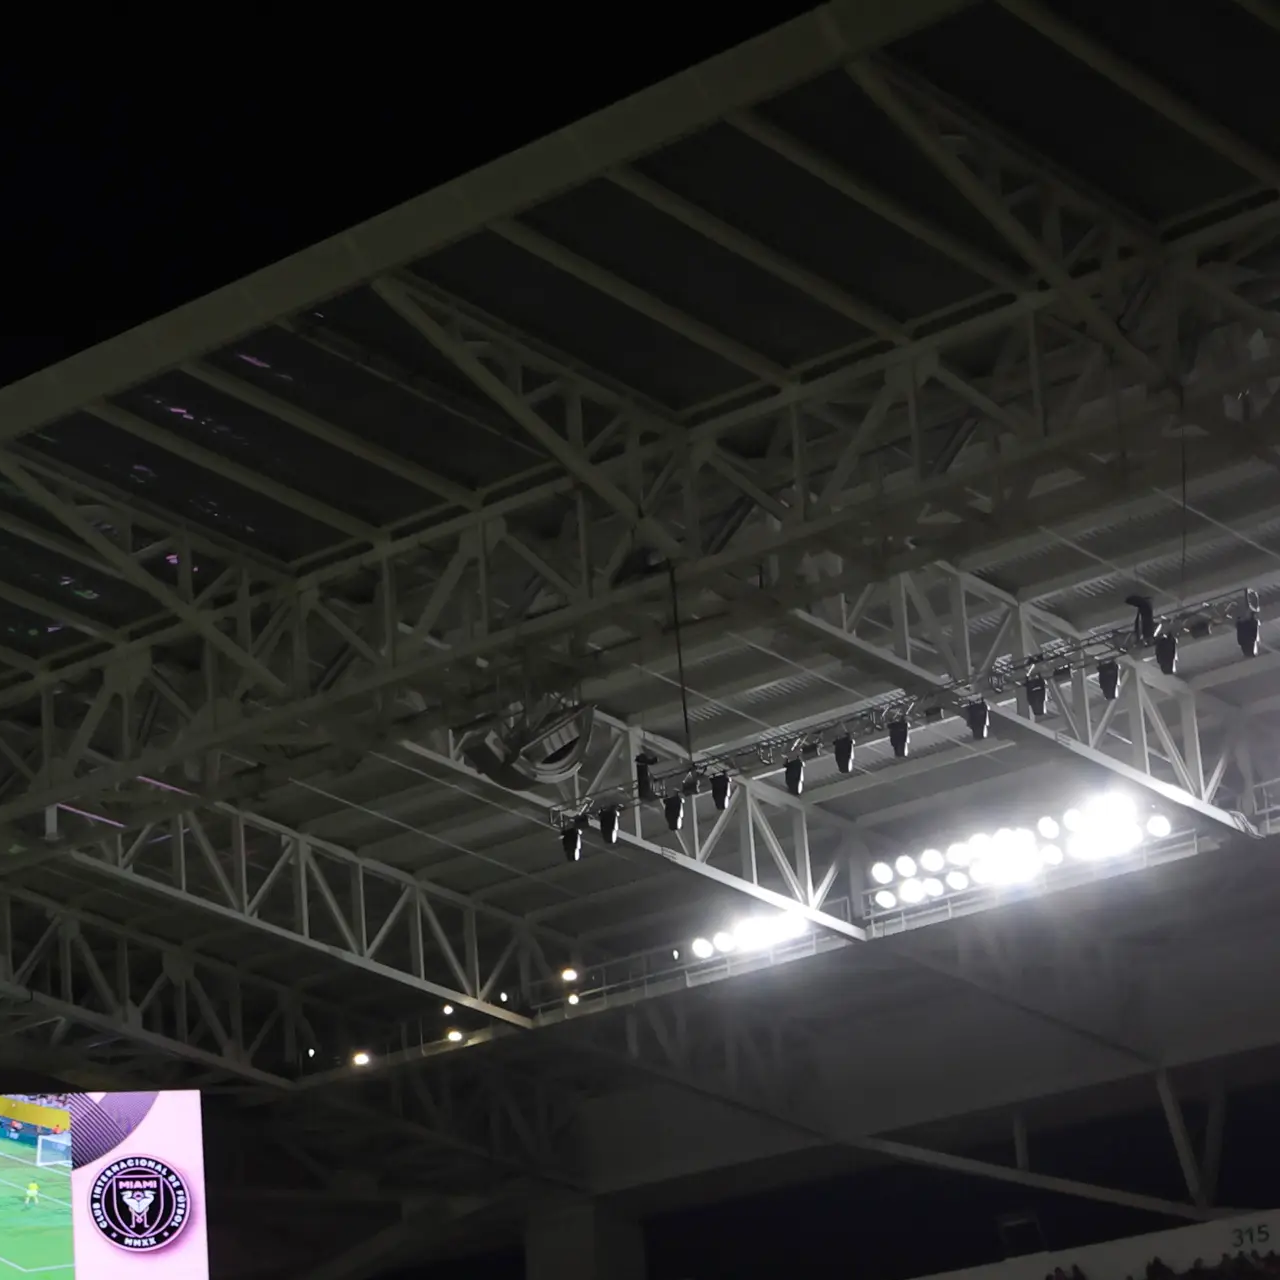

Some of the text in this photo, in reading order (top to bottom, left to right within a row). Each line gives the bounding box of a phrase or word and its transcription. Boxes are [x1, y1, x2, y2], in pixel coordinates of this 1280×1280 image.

[92, 1158, 169, 1199] INTERNACIONAL
[118, 1180, 158, 1189] MIAMI
[168, 1174, 181, 1188] DE
[91, 1202, 108, 1229] CLUB
[1231, 1225, 1270, 1247] 315
